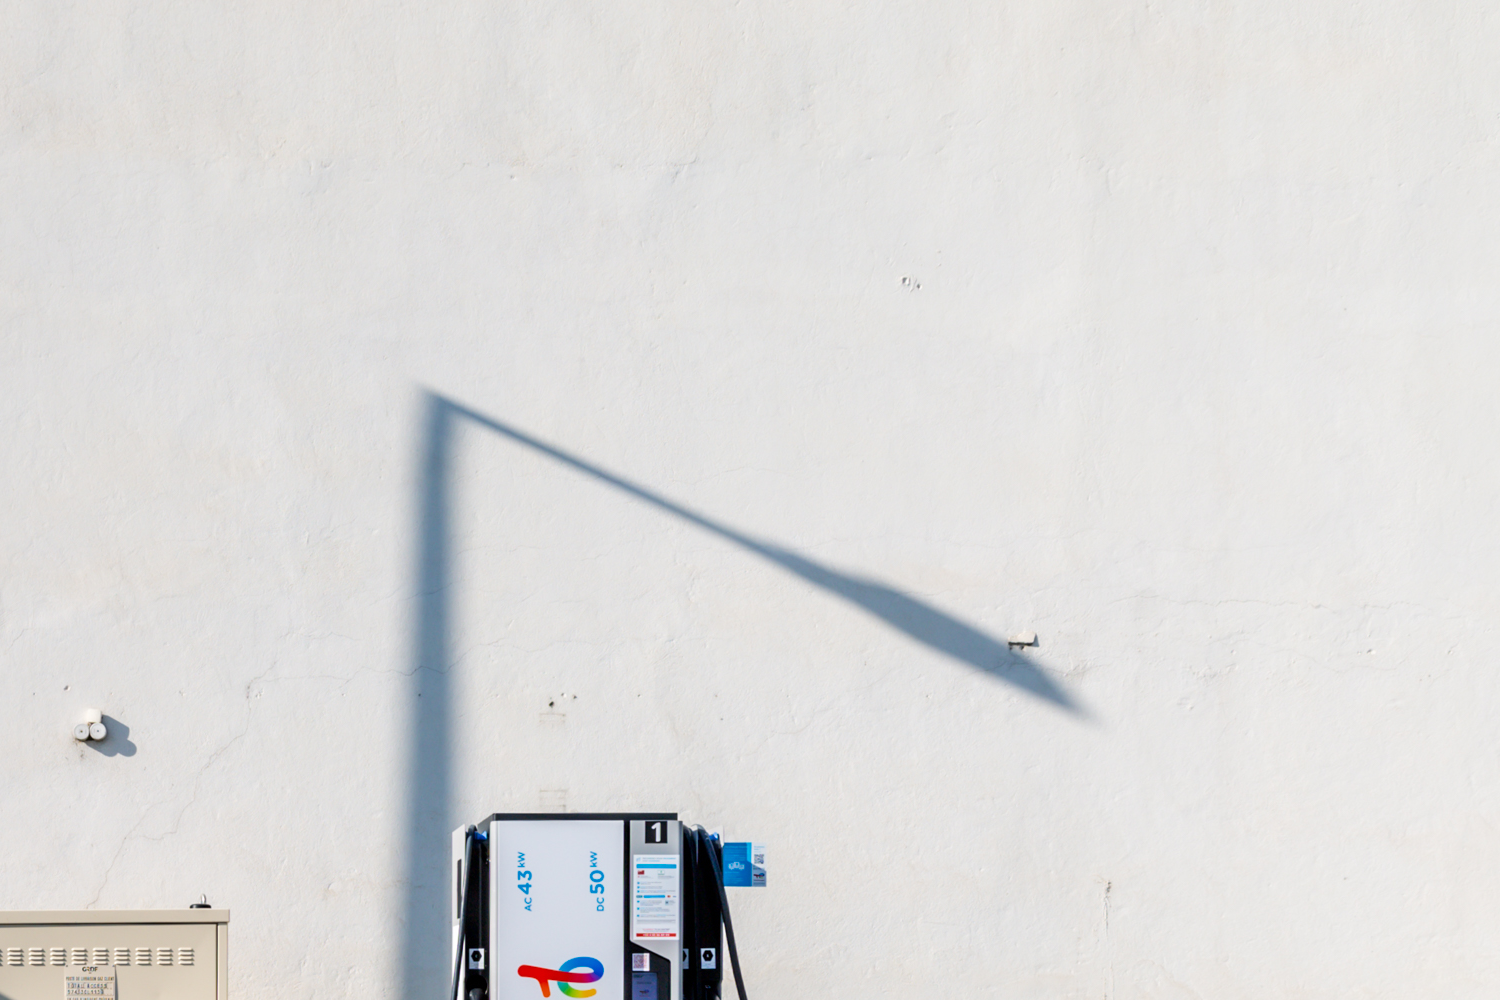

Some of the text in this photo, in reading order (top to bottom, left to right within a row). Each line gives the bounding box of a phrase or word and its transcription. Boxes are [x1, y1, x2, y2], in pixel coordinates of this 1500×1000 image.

[651, 822, 661, 842] 1
[517, 851, 532, 912] AC 43 kW
[589, 851, 604, 912] DC 50 kW
